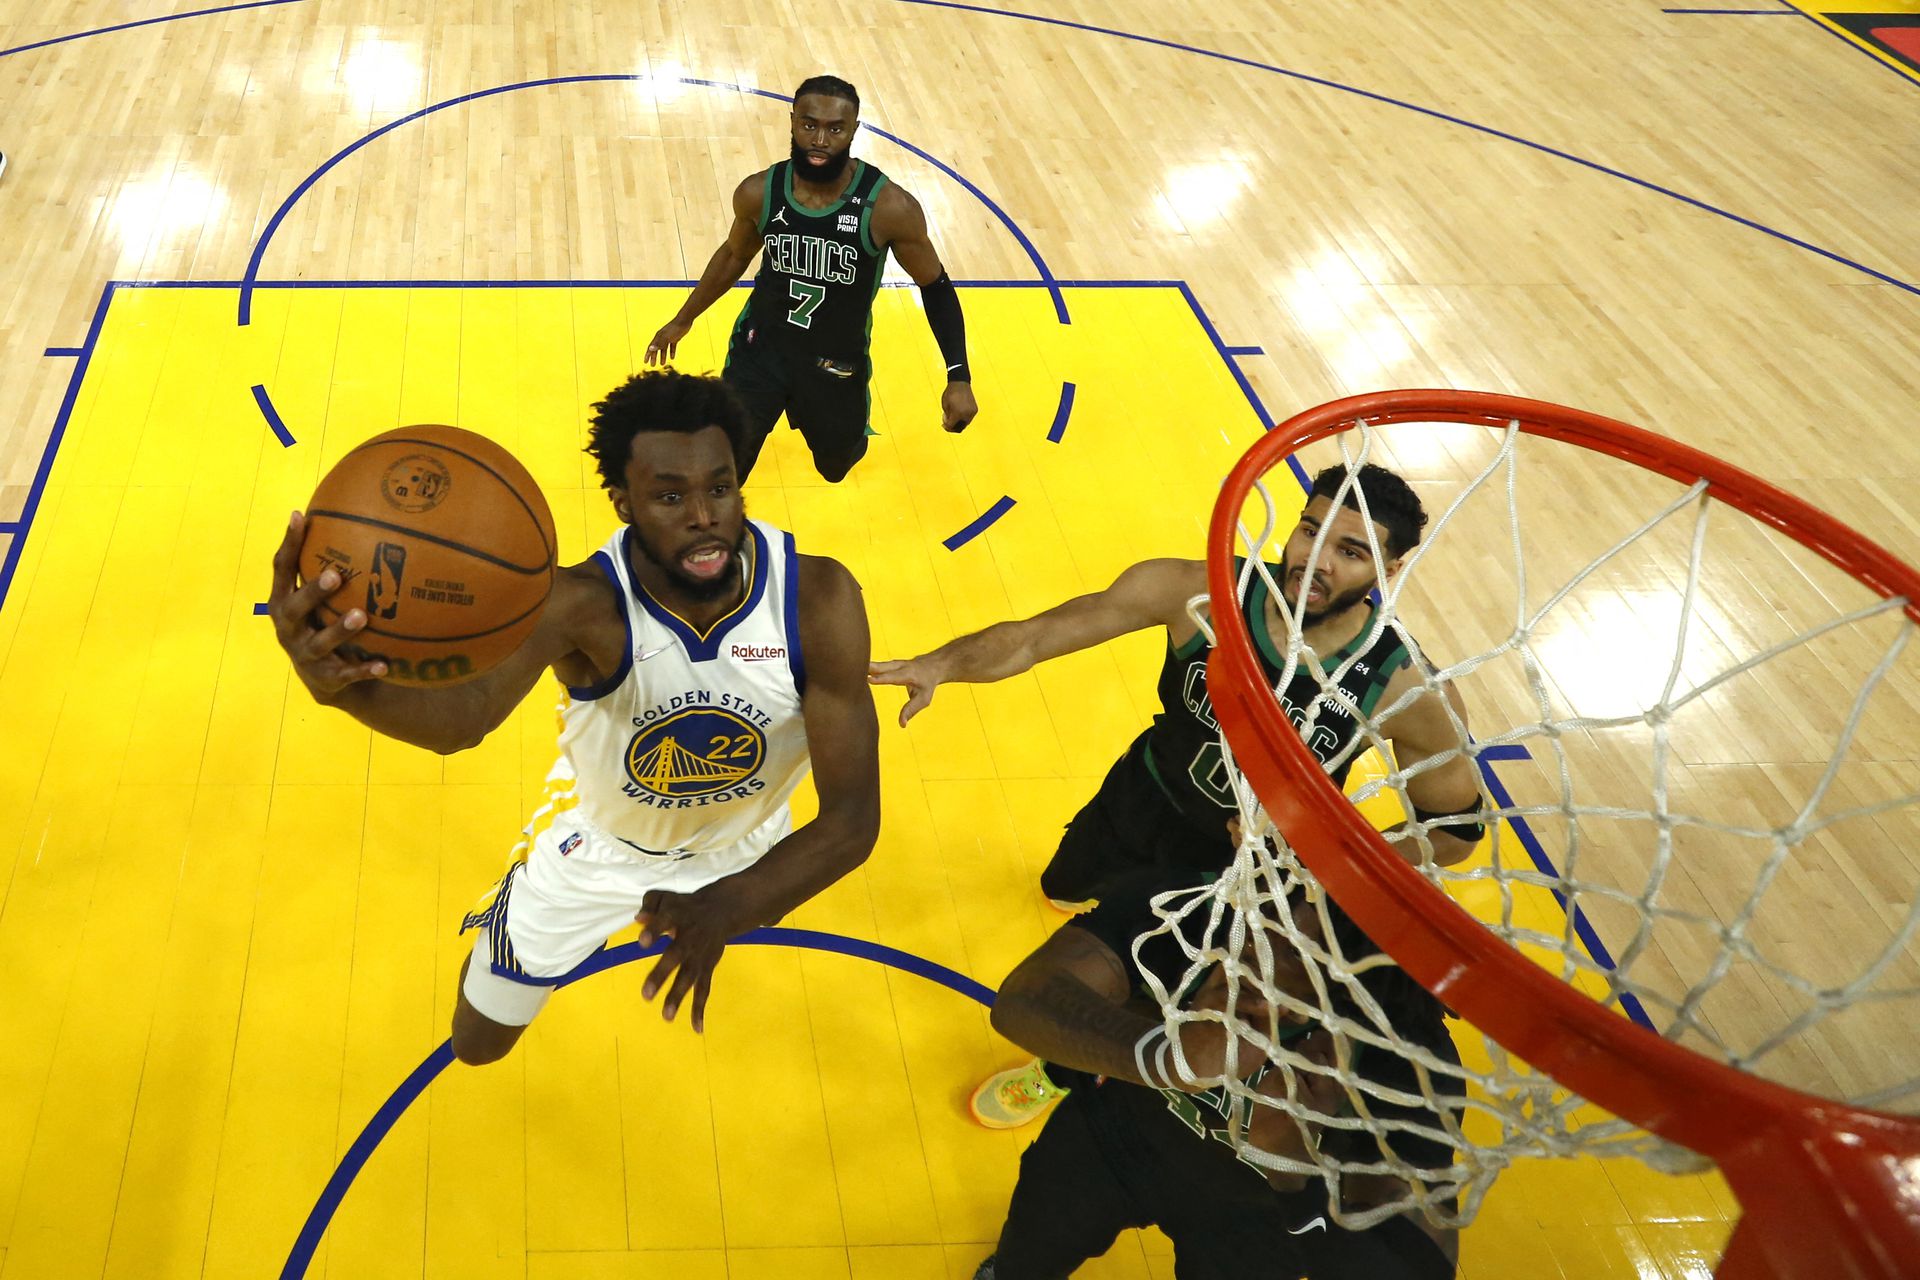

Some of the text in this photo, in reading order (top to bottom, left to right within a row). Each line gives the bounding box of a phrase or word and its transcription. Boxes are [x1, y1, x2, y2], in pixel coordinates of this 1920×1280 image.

[851, 196, 861, 205] 24
[837, 223, 859, 233] PRINT
[838, 214, 859, 226] VISTA
[764, 233, 858, 285] CELTICS
[787, 279, 826, 330] 7
[731, 645, 786, 659] Rakuten
[1355, 662, 1370, 676] 24
[632, 690, 772, 729] GOLDEN STATE
[706, 734, 755, 760] 22
[621, 778, 766, 809] WARRIORS
